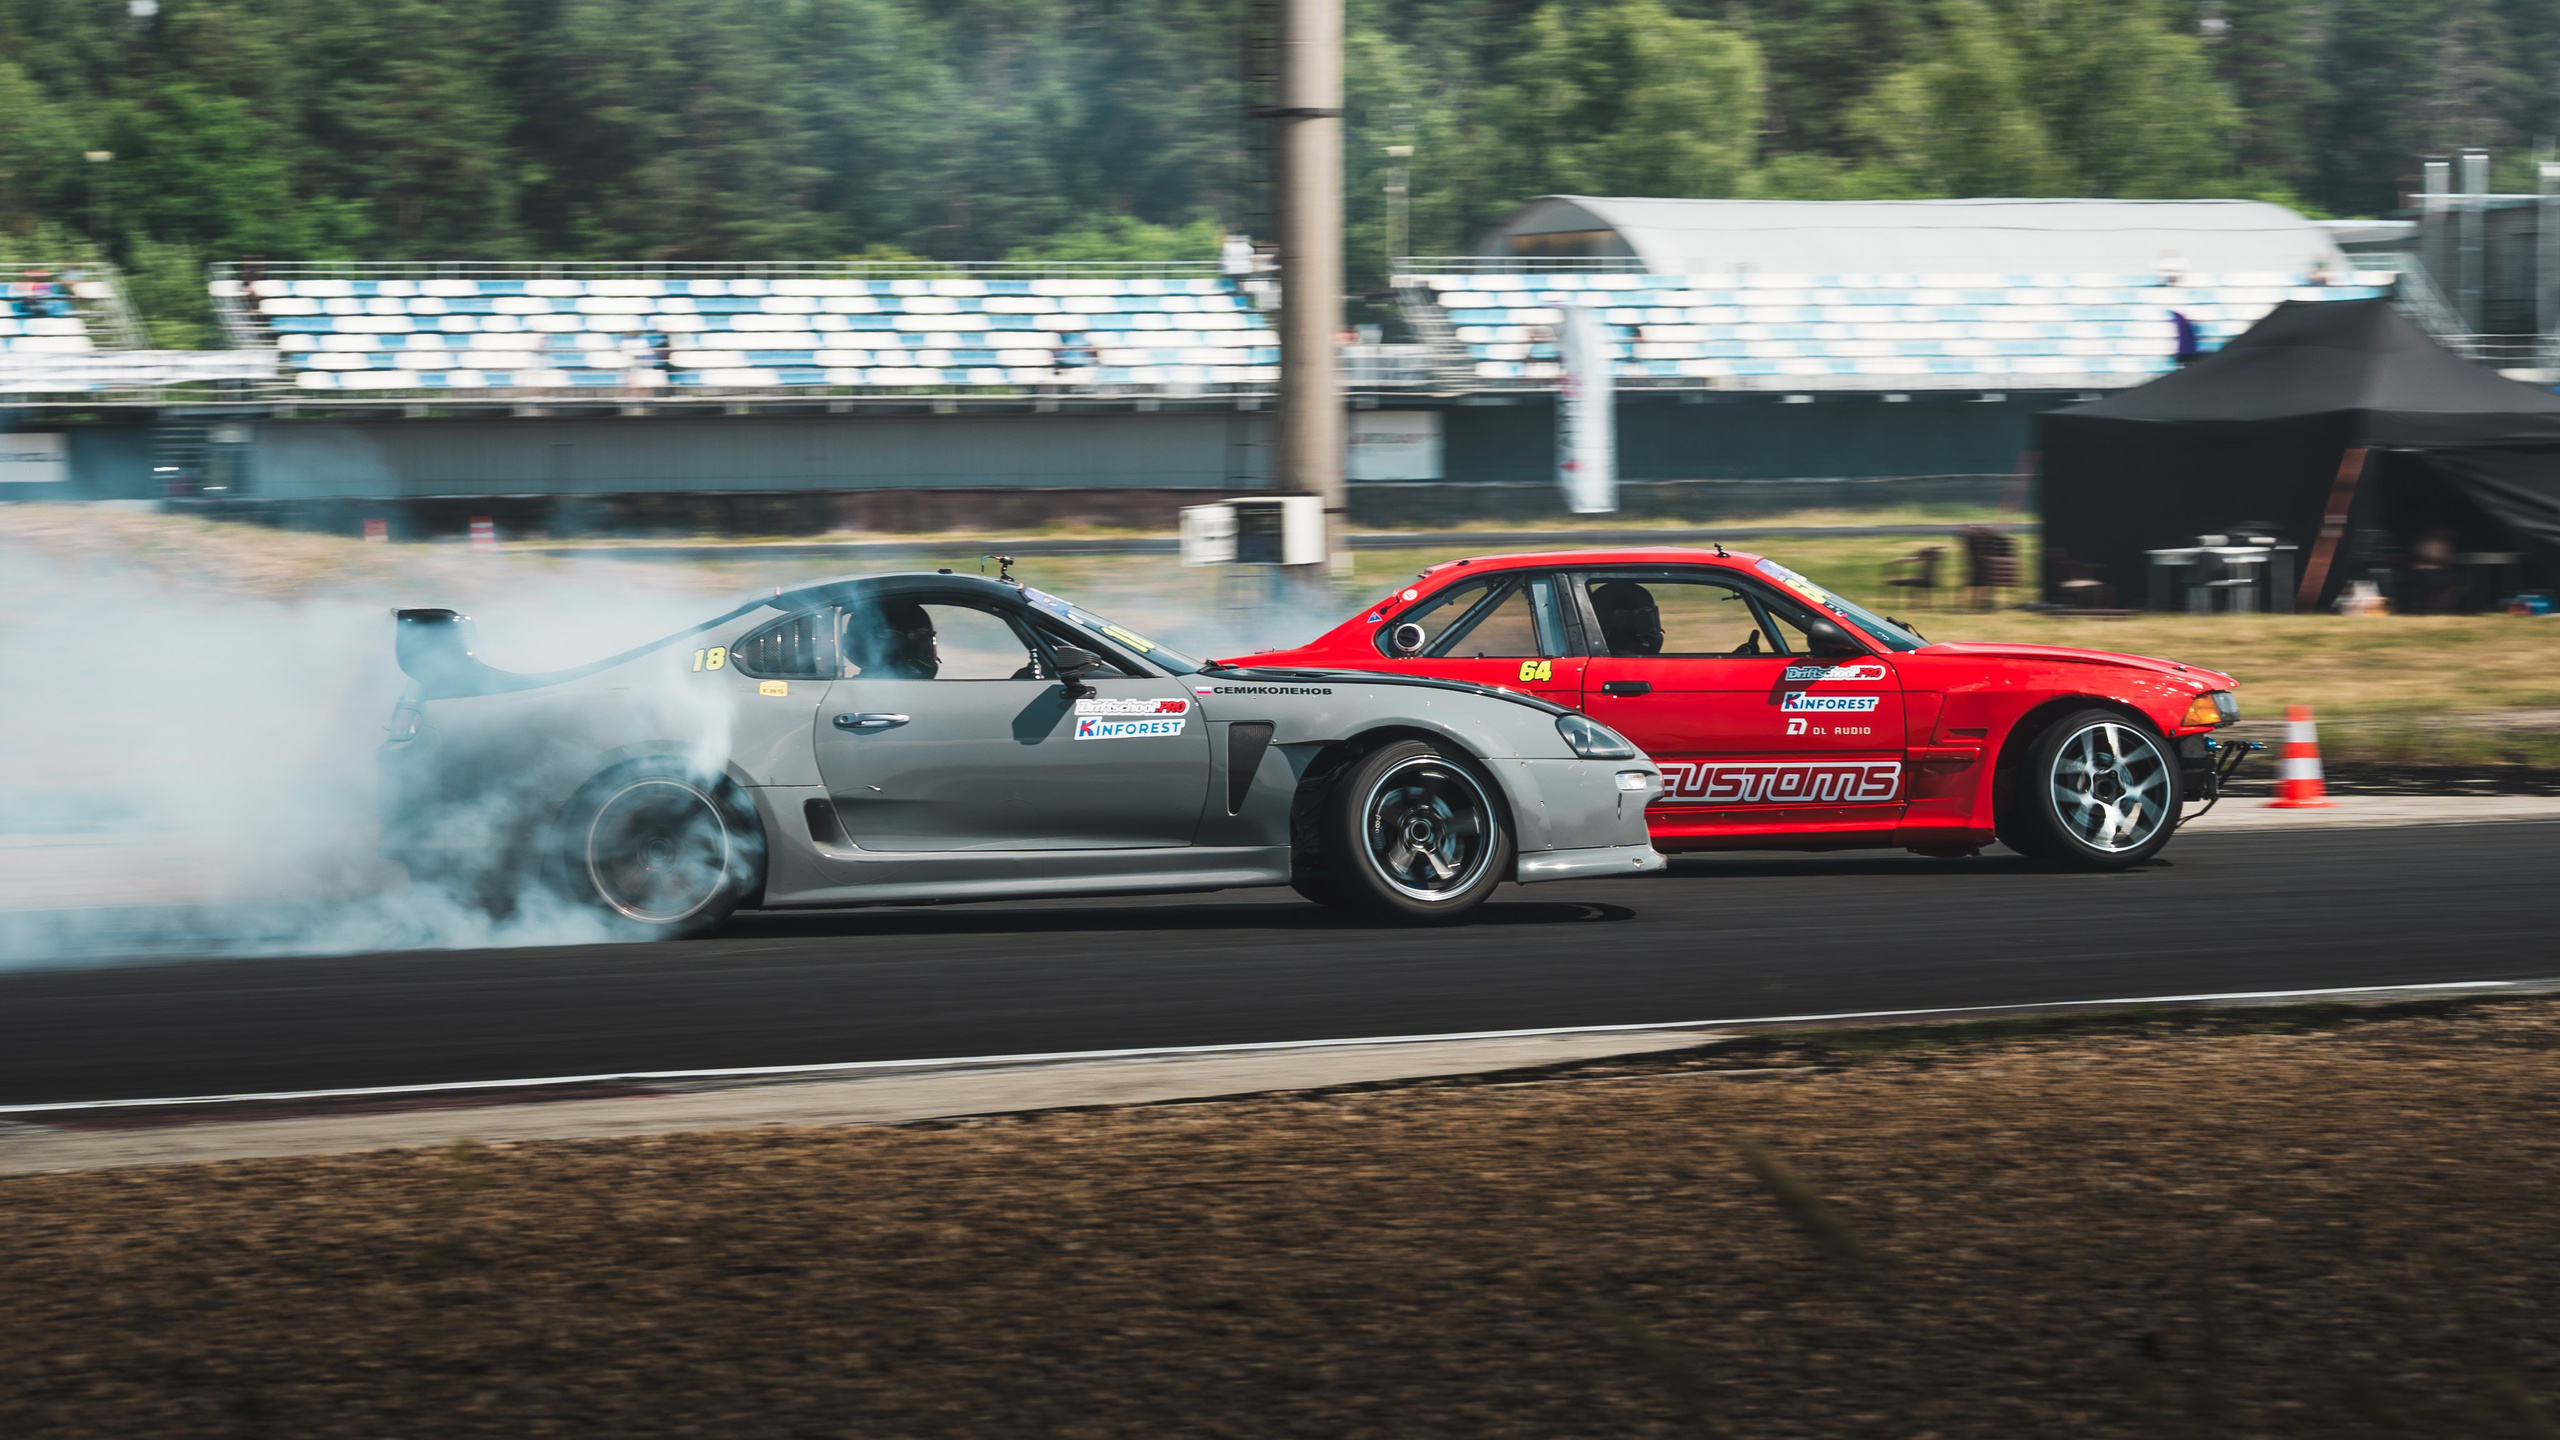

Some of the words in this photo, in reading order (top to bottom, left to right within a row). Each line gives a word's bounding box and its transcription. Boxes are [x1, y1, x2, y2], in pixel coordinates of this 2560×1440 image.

[691, 645, 727, 673] 18
[1518, 659, 1553, 683] 64
[1213, 686, 1333, 695] СЕМИКОЛЕНОВ
[1784, 693, 1876, 710] KINFOREST
[1078, 719, 1182, 737] KINFOREST
[1813, 727, 1827, 735] DL
[1834, 727, 1871, 735] AUDIO
